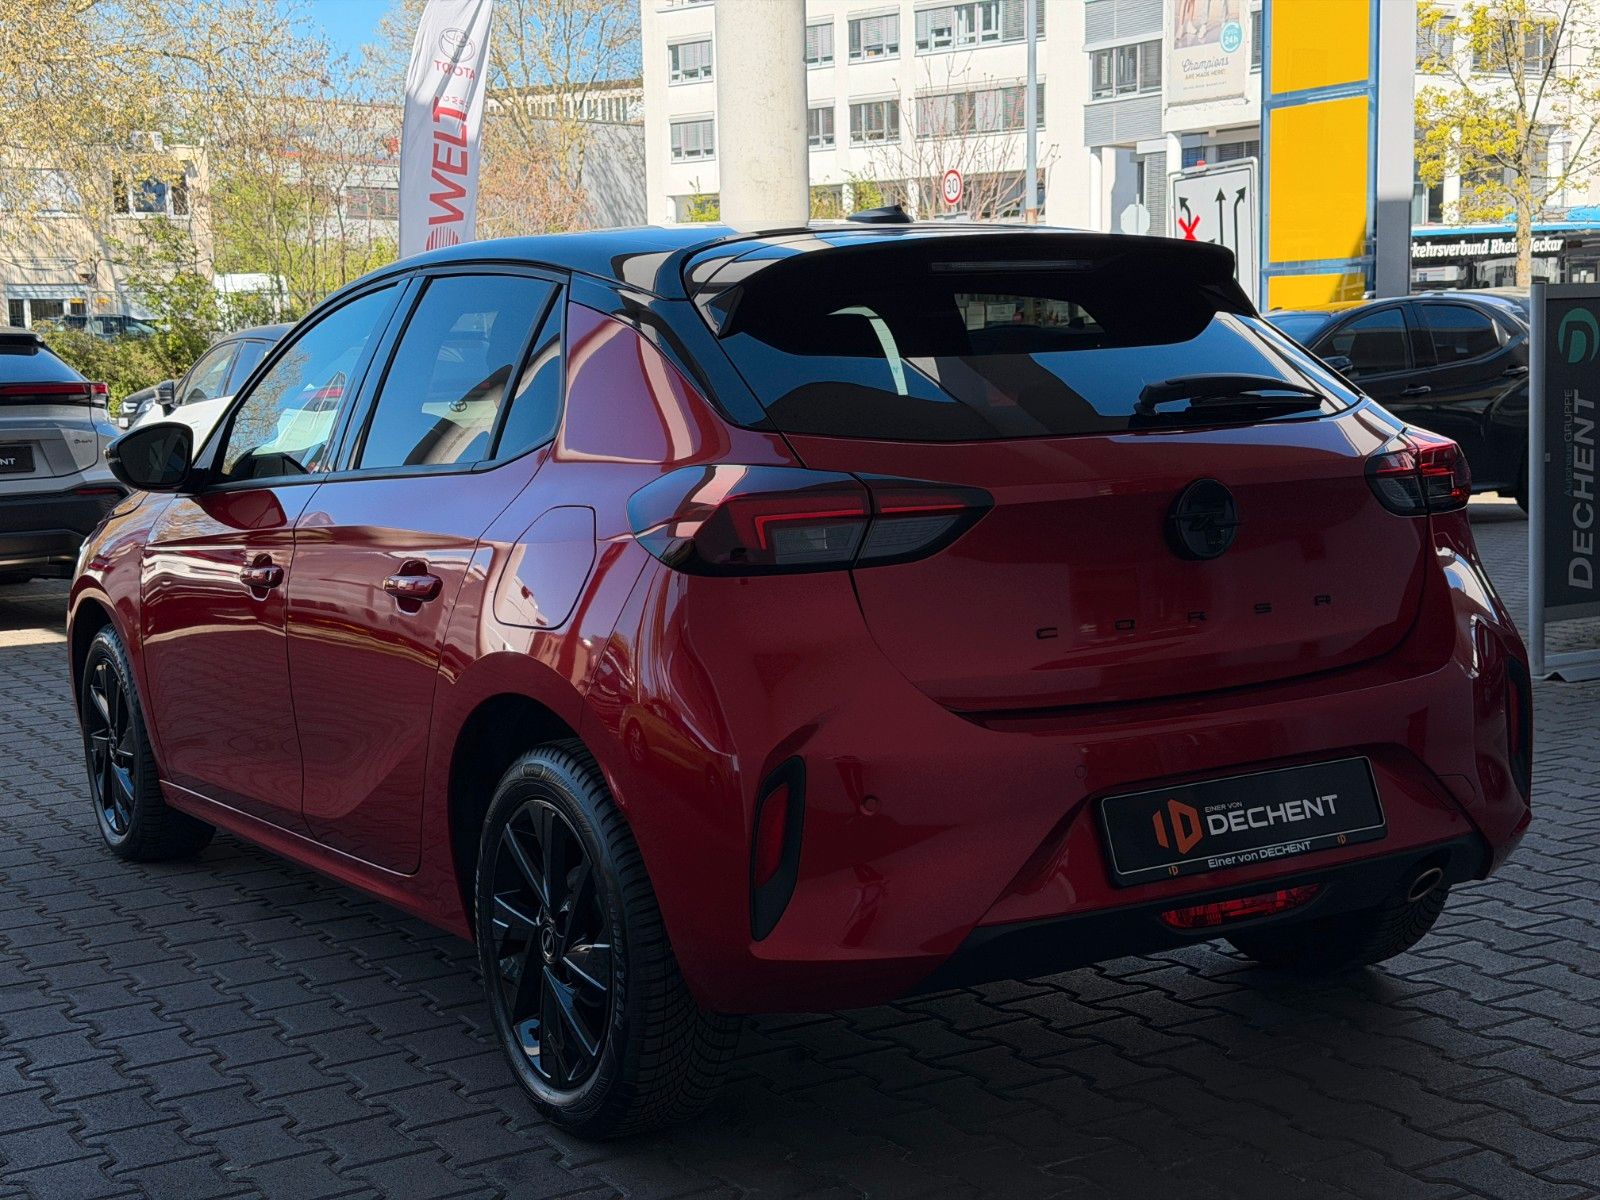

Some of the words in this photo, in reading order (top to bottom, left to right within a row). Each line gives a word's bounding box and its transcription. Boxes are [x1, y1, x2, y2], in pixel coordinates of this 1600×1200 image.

[433, 60, 476, 80] TOYOTA
[428, 96, 468, 225] WELT
[946, 178, 958, 194] 30
[1411, 238, 1489, 258] kehrsverbund
[0, 457, 16, 466] NT
[1568, 388, 1595, 590] DECHENT
[1036, 594, 1332, 640] CORSA
[1204, 803, 1227, 813] EINER
[1227, 801, 1243, 809] VON
[1206, 794, 1338, 836] DECHENT
[1207, 855, 1236, 869] Einer
[1237, 851, 1259, 863] von
[1259, 841, 1311, 859] DECHENT
